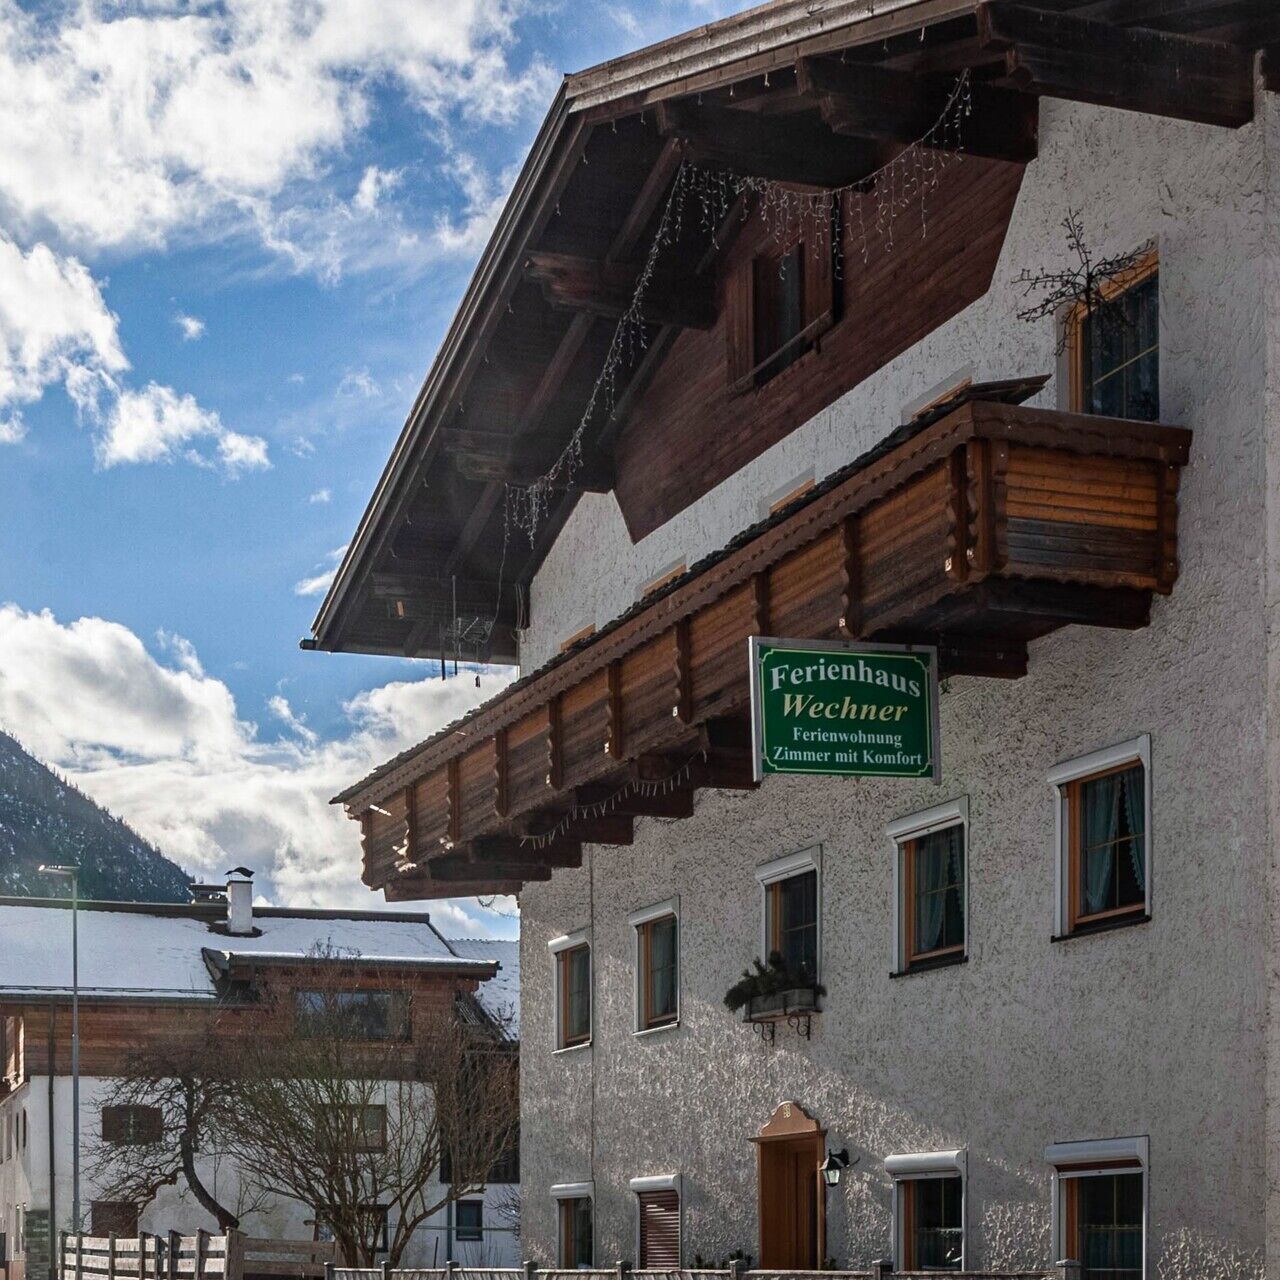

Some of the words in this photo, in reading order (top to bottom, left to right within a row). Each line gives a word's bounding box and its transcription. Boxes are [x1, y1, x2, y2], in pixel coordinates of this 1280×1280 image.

[770, 658, 921, 698] Ferienhaus
[783, 693, 908, 722] Wechner
[792, 727, 902, 748] Ferienwohnung
[773, 746, 831, 762] Zimmer
[835, 749, 858, 763] mit
[863, 750, 922, 765] Komfort
